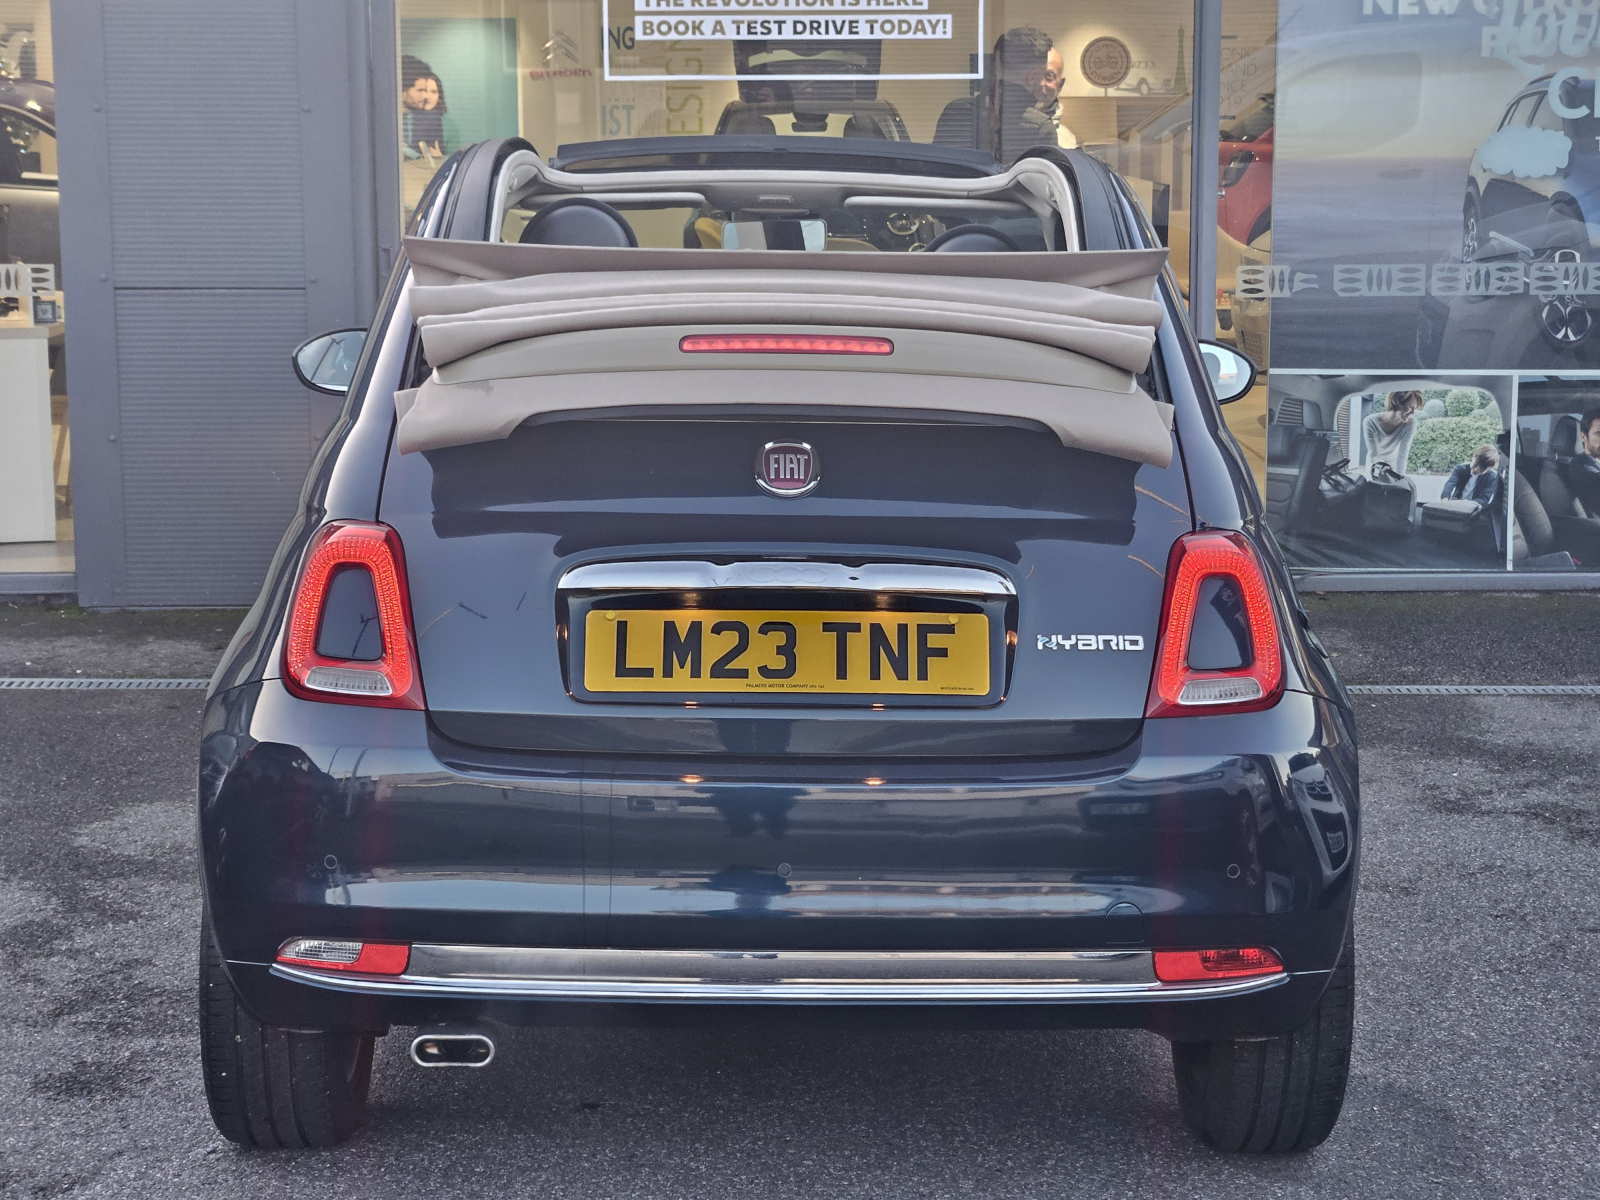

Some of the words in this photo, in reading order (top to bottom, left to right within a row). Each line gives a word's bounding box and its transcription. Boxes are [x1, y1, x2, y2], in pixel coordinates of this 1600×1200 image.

[642, 20, 705, 36] BOOK
[711, 20, 727, 36] A
[731, 20, 786, 36] TEST
[792, 20, 860, 36] DRIVE
[865, 19, 948, 36] TODAY!
[769, 453, 808, 479] FIAT
[614, 620, 797, 679] LM23
[822, 622, 956, 681] TNF
[1037, 635, 1144, 650] HYBRID
